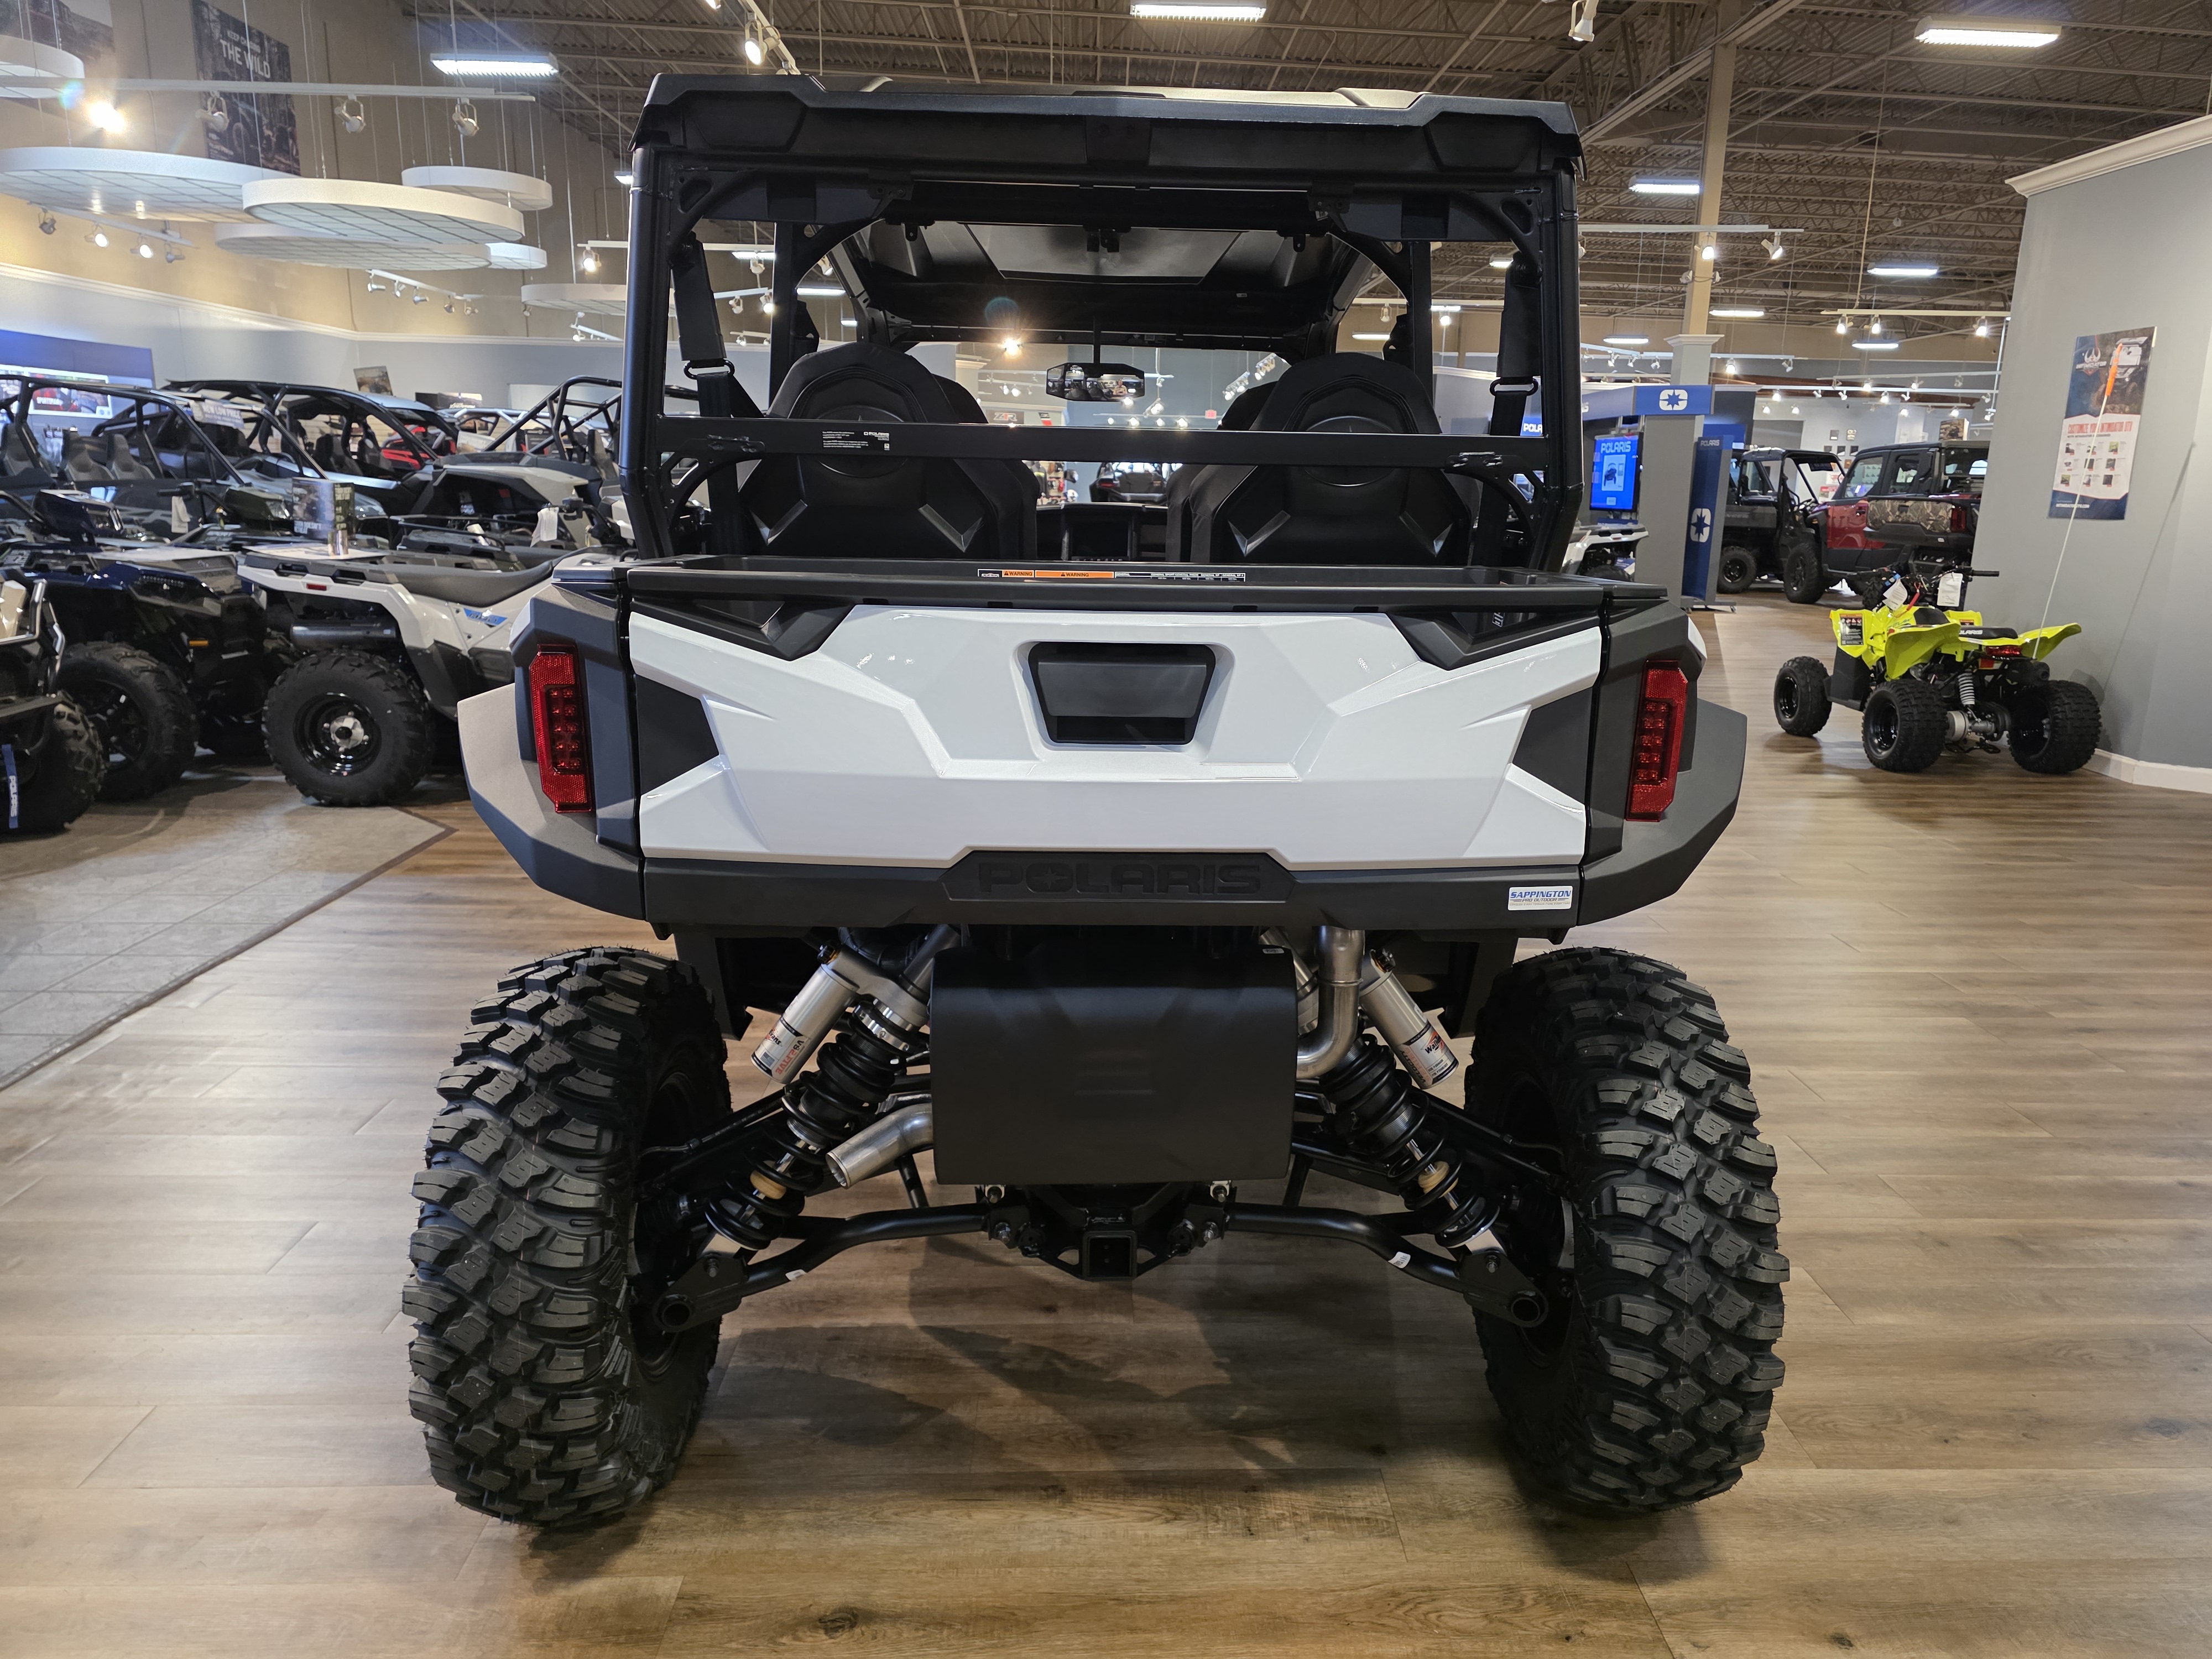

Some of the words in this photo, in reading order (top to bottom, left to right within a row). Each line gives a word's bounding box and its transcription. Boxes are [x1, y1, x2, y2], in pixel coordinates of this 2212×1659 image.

[220, 39, 242, 65] THE
[243, 50, 270, 79] WILD
[1524, 423, 1542, 432] POLA
[1601, 441, 1631, 453] POLARIS
[9, 775, 17, 817] POLARIS
[979, 862, 1261, 895] POLARIS
[1510, 890, 1572, 899] SAPPINGTON
[1400, 1050, 1426, 1083] VELOCITY
[1404, 1047, 1431, 1082] SERIES
